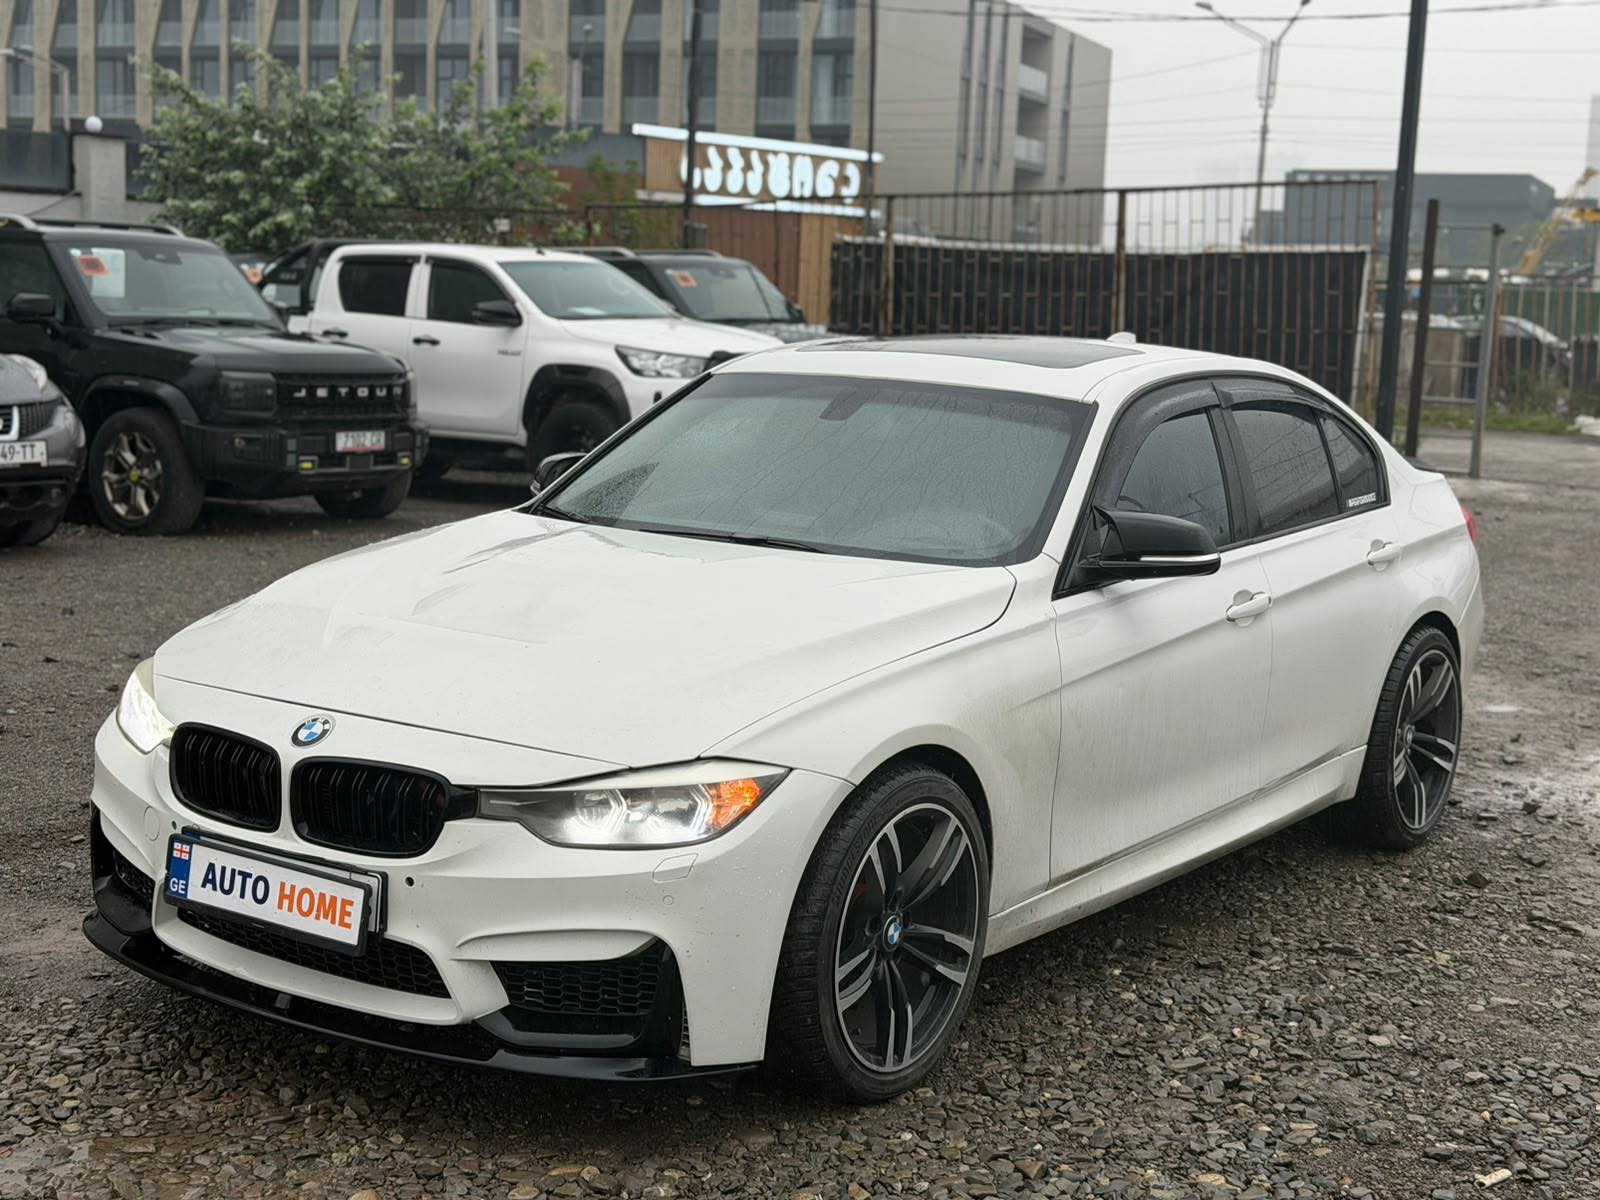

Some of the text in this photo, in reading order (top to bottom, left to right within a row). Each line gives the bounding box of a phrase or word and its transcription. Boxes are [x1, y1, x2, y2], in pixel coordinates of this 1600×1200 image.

[169, 877, 186, 895] GE
[201, 862, 355, 930] AUTO HOME
